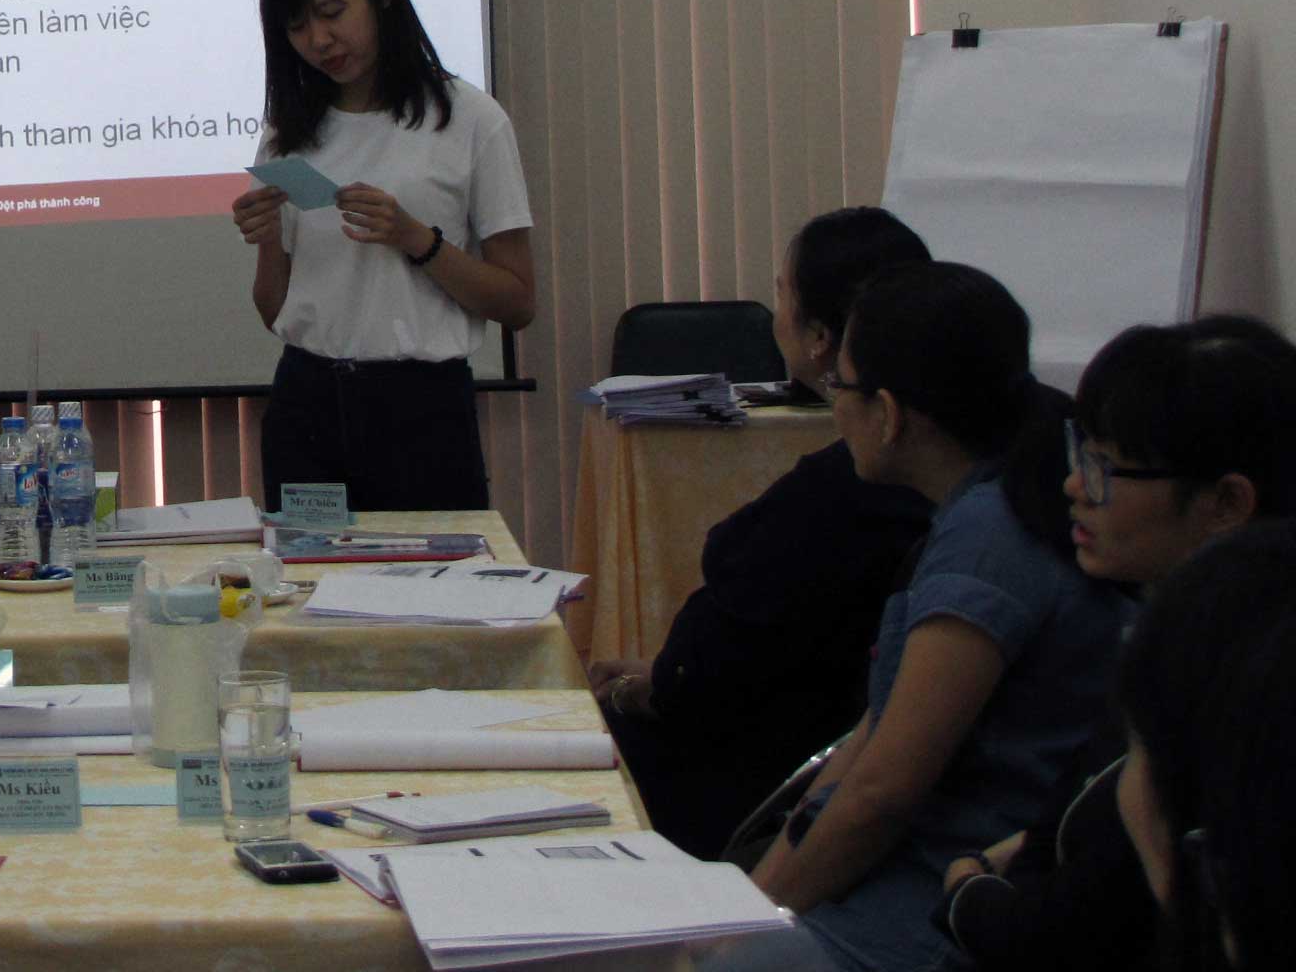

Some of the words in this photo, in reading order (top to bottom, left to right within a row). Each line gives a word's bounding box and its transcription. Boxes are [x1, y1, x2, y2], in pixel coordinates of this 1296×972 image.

[39, 9, 88, 34] làm
[97, 5, 151, 34] việc
[23, 122, 92, 147] tham
[102, 117, 142, 148] gia
[152, 114, 218, 140] khóa
